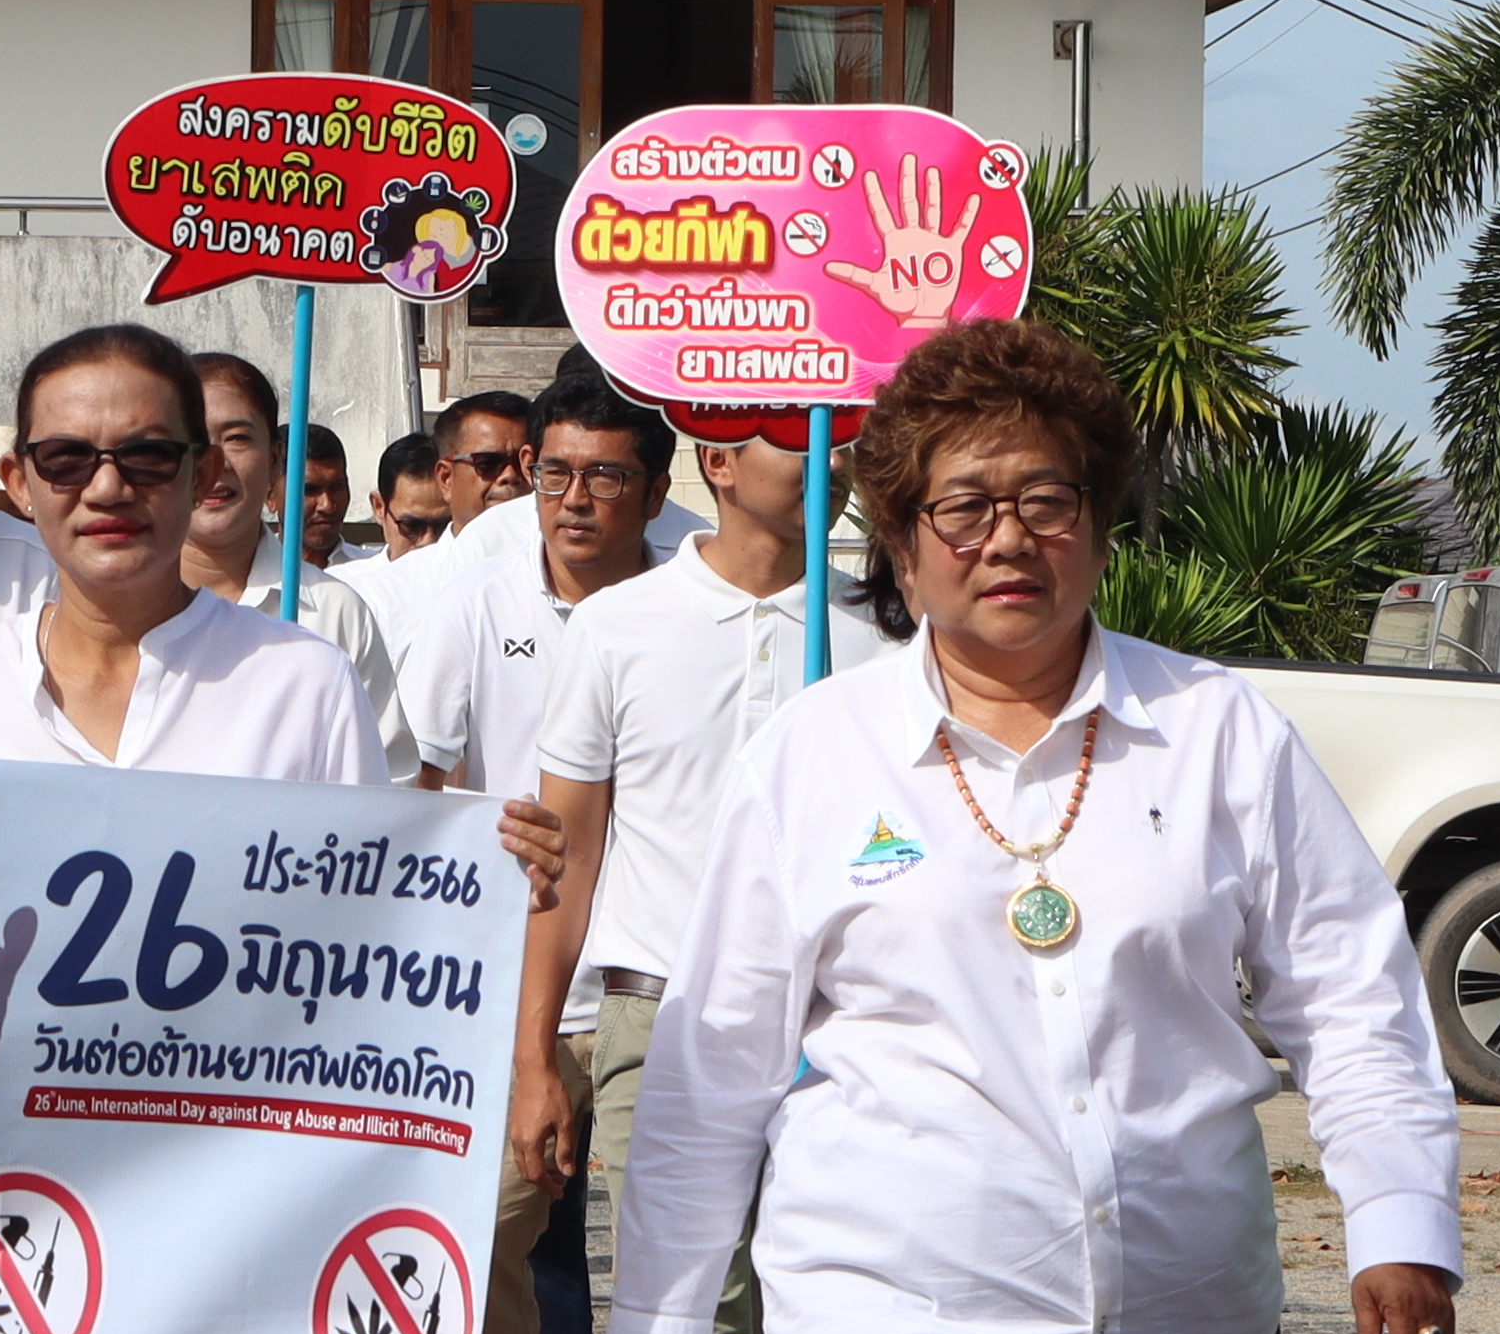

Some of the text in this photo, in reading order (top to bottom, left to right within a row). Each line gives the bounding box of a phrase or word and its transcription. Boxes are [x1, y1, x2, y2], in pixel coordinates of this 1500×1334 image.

[178, 96, 478, 162] สงครามดับชีวิต
[614, 140, 797, 176] สร้างตัวตน
[128, 151, 344, 207] ยาเสพติด
[171, 205, 355, 264] ดับอนาคต
[579, 203, 769, 264] ด้วยกีฬา
[889, 251, 954, 291] NO
[607, 282, 807, 328] ดีกว่าพึ่งพา
[680, 344, 846, 381] ยาเสพติด
[243, 830, 482, 908] ประจำปี 2566
[36, 849, 484, 1025] 26 มิถุนายน
[33, 1023, 475, 1110] วันต่อต้านยาเสพติดโลก
[91, 1096, 177, 1117] International
[180, 1100, 206, 1122] Day
[209, 1102, 258, 1124] against
[261, 1105, 293, 1130] Drug
[294, 1108, 336, 1131] Abuse
[338, 1113, 365, 1134] and
[366, 1114, 399, 1138] Illicit
[402, 1119, 465, 1154] Trafficking
